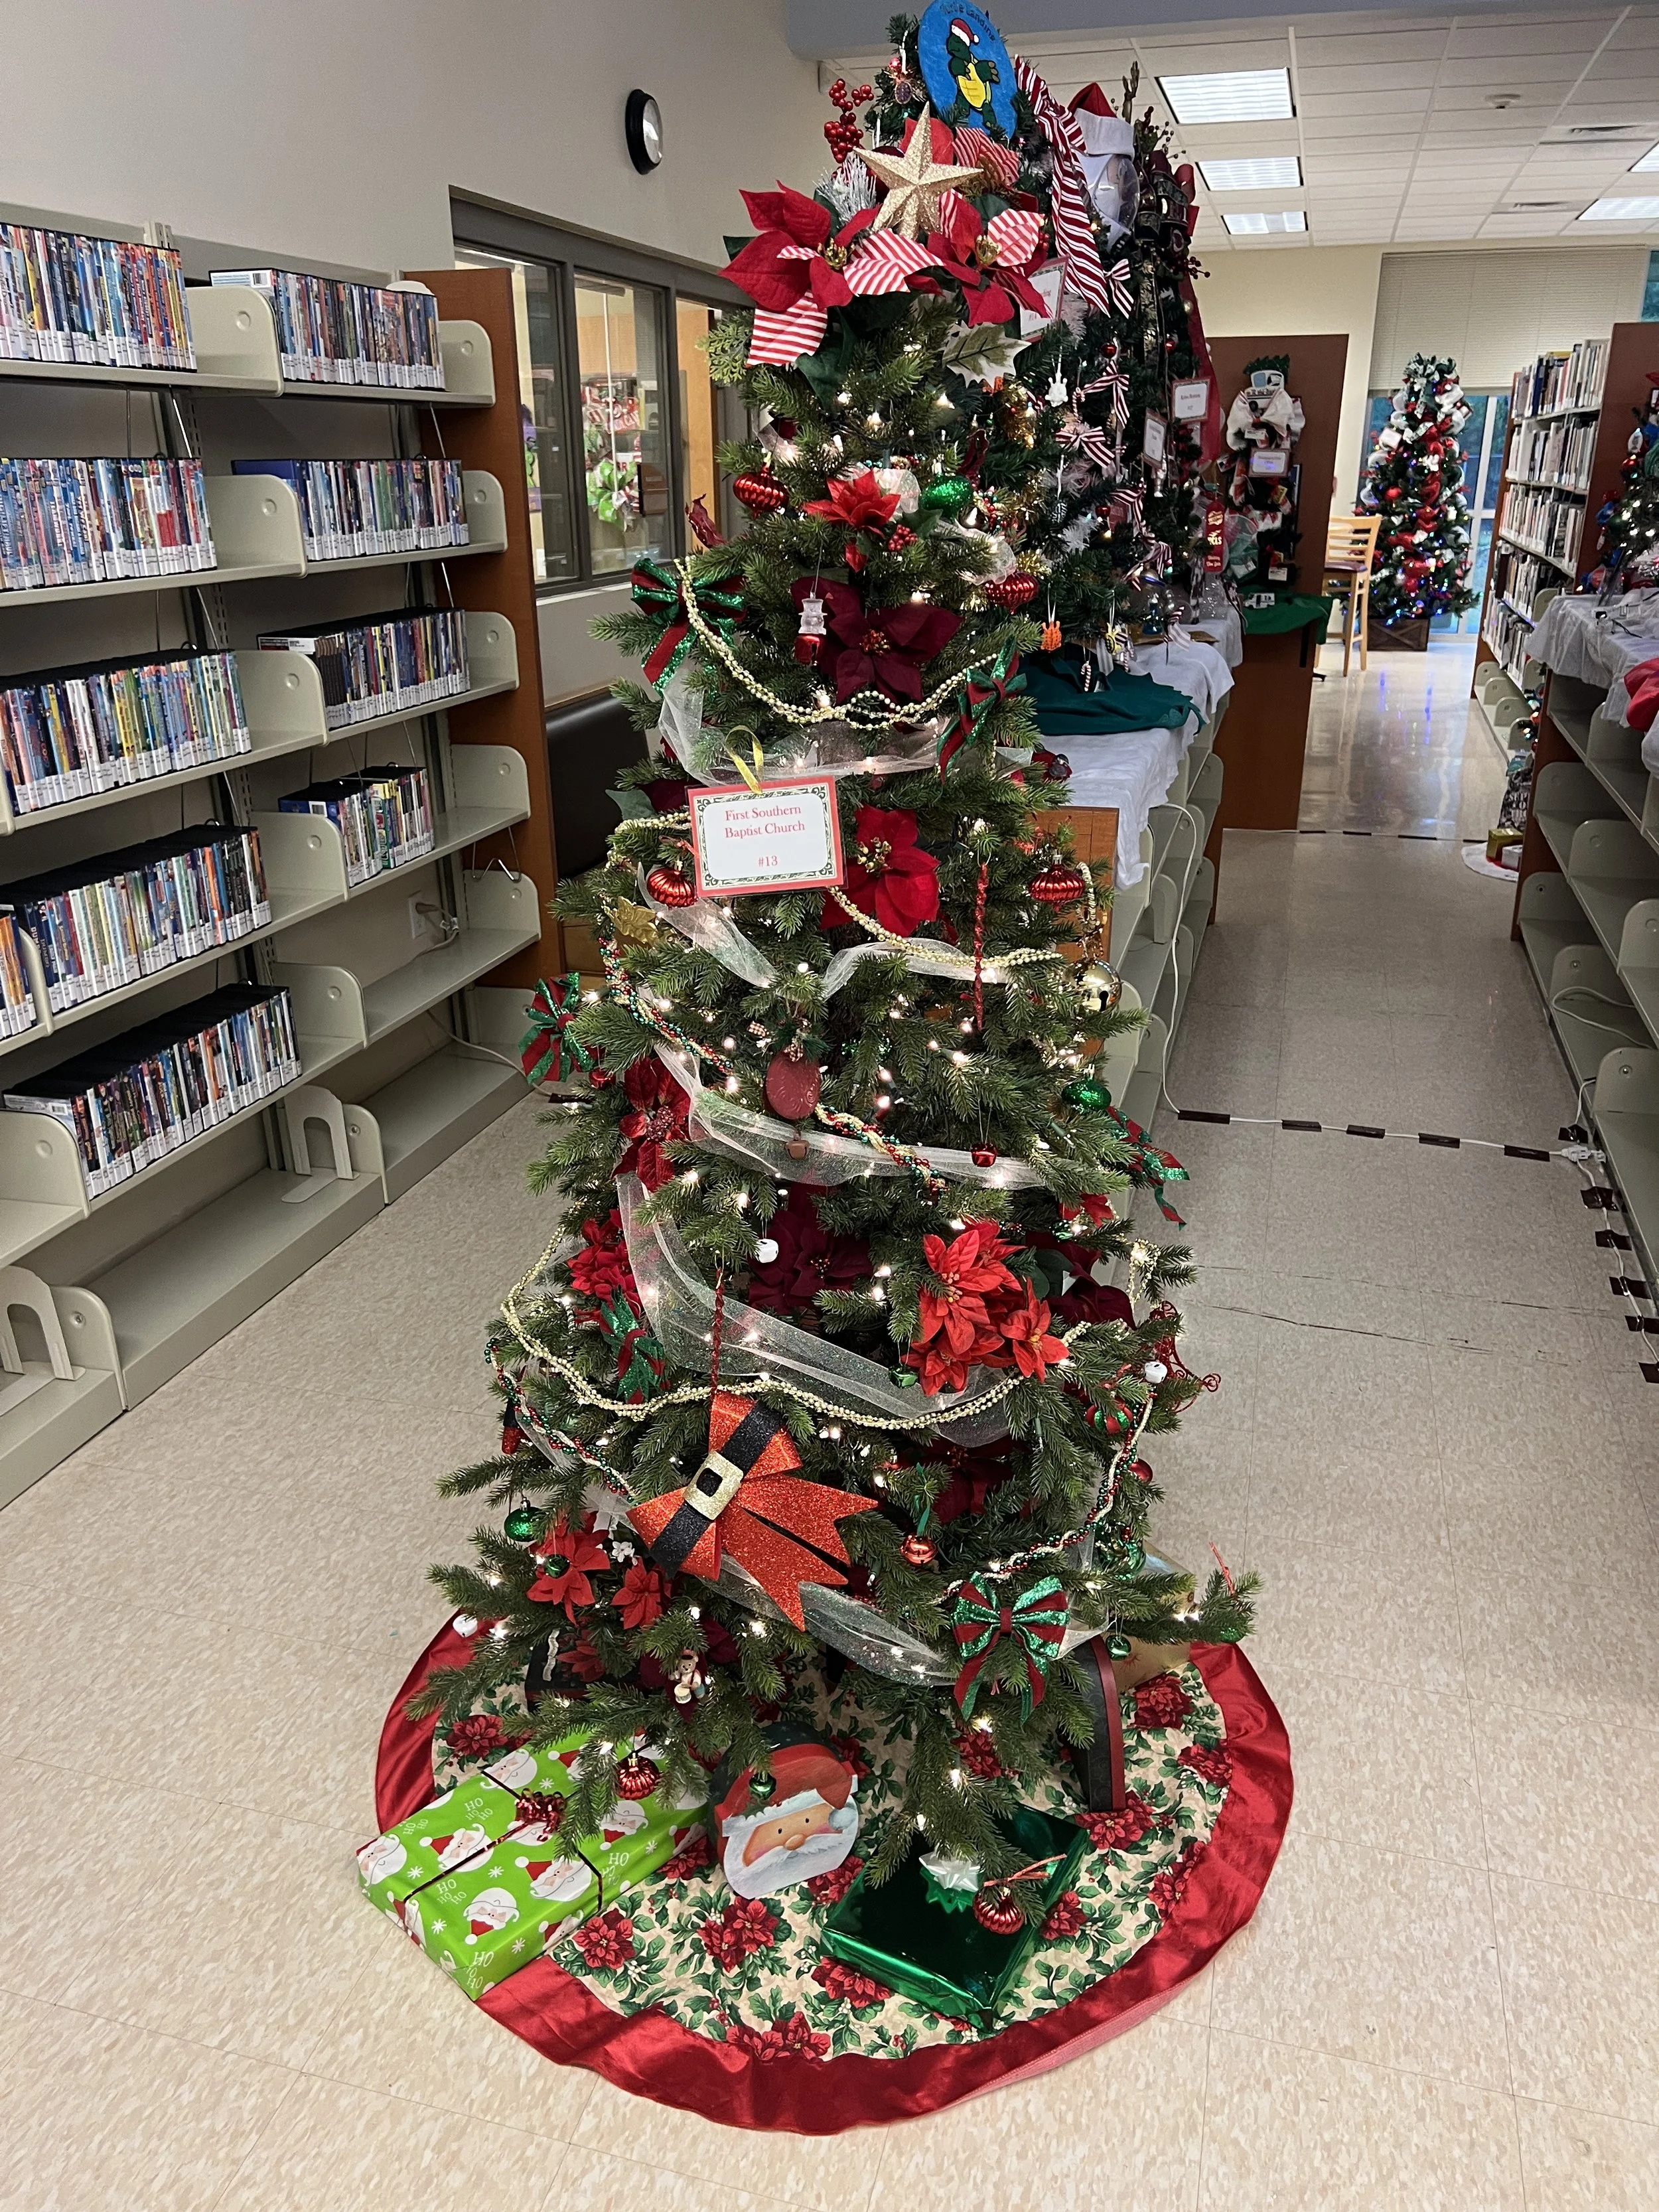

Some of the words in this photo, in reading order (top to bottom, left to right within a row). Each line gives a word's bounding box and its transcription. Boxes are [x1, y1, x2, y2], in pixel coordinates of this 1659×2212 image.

[725, 809, 749, 821] First
[752, 804, 802, 818] Southern
[725, 825, 763, 839] Baptist
[764, 821, 806, 834] Church
[758, 855, 778, 867] #13
[465, 1797, 484, 1811] HO
[466, 1809, 479, 1820] HO
[478, 1808, 493, 1820] HO
[403, 1822, 416, 1835] HO
[417, 1818, 429, 1829] HO
[609, 1852, 629, 1866] HO
[436, 1879, 457, 1894] HO
[437, 1892, 452, 1904] HO
[451, 1891, 467, 1904] HO
[472, 1951, 494, 1967] HO
[467, 1976, 483, 1989] HO
